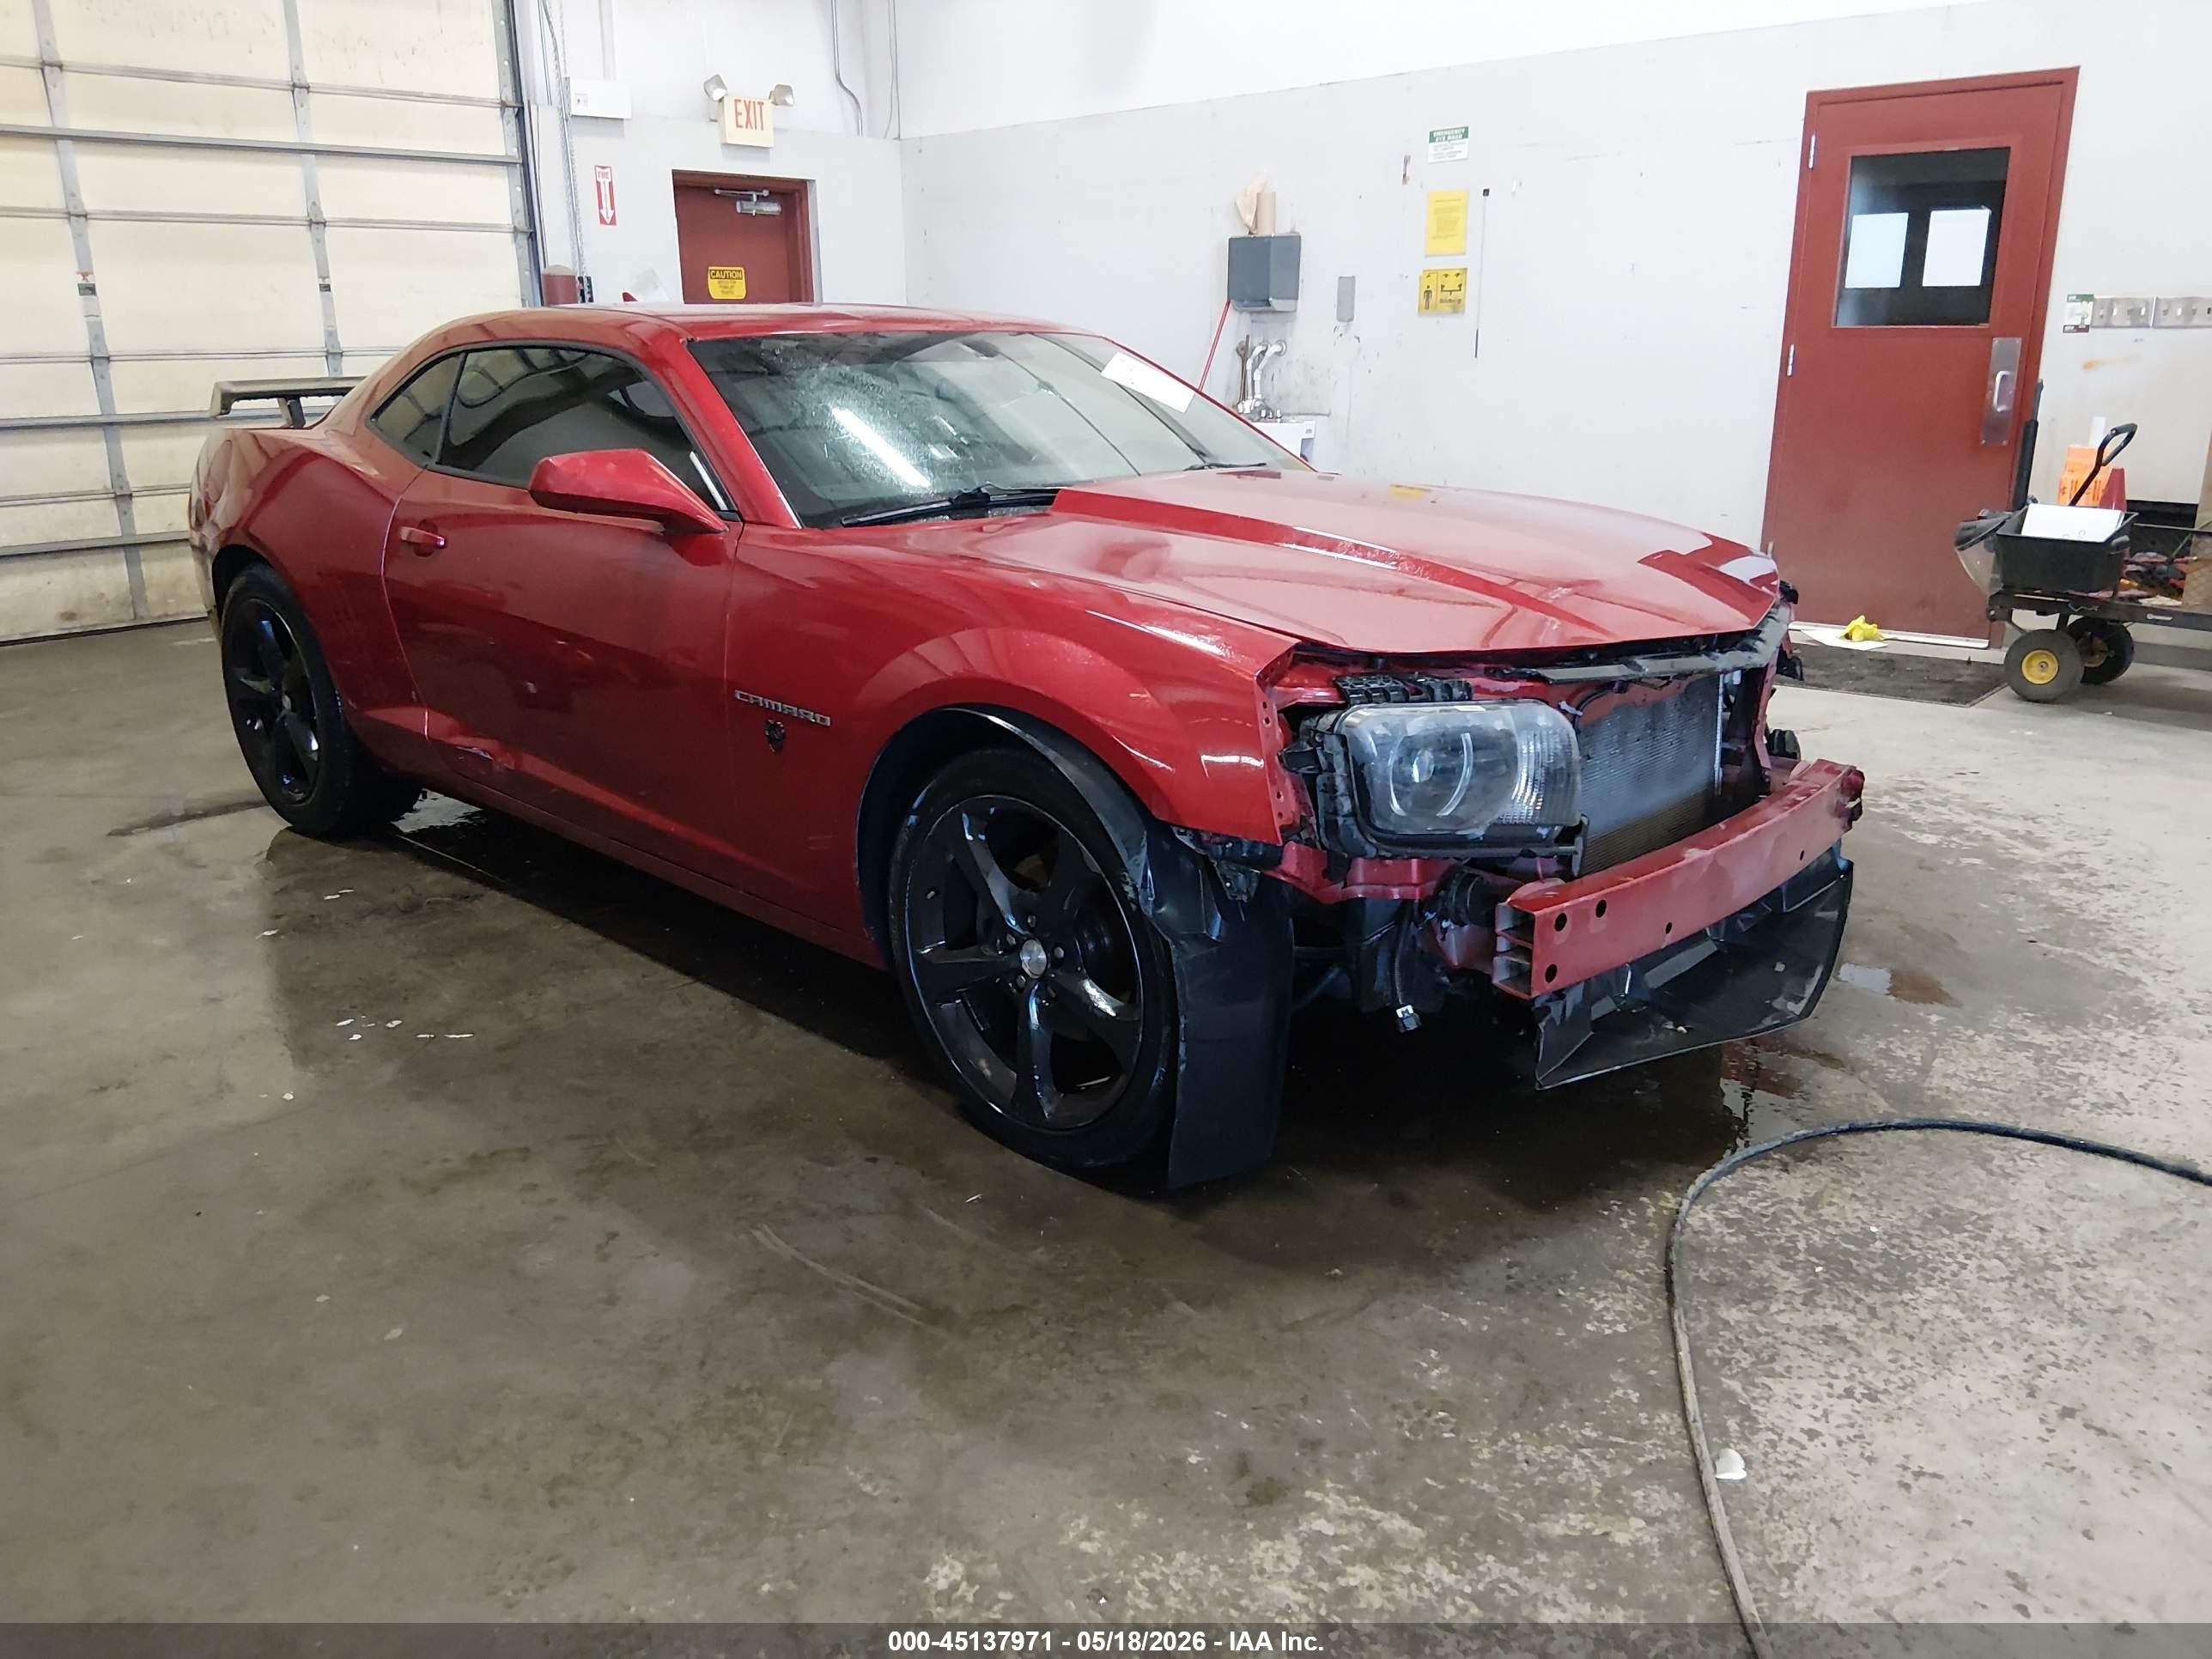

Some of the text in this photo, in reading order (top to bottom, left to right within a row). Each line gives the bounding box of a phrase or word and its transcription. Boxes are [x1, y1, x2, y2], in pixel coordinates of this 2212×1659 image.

[734, 99, 764, 131] EXIT
[710, 270, 742, 279] CAUTION
[734, 690, 831, 726] CAMARO
